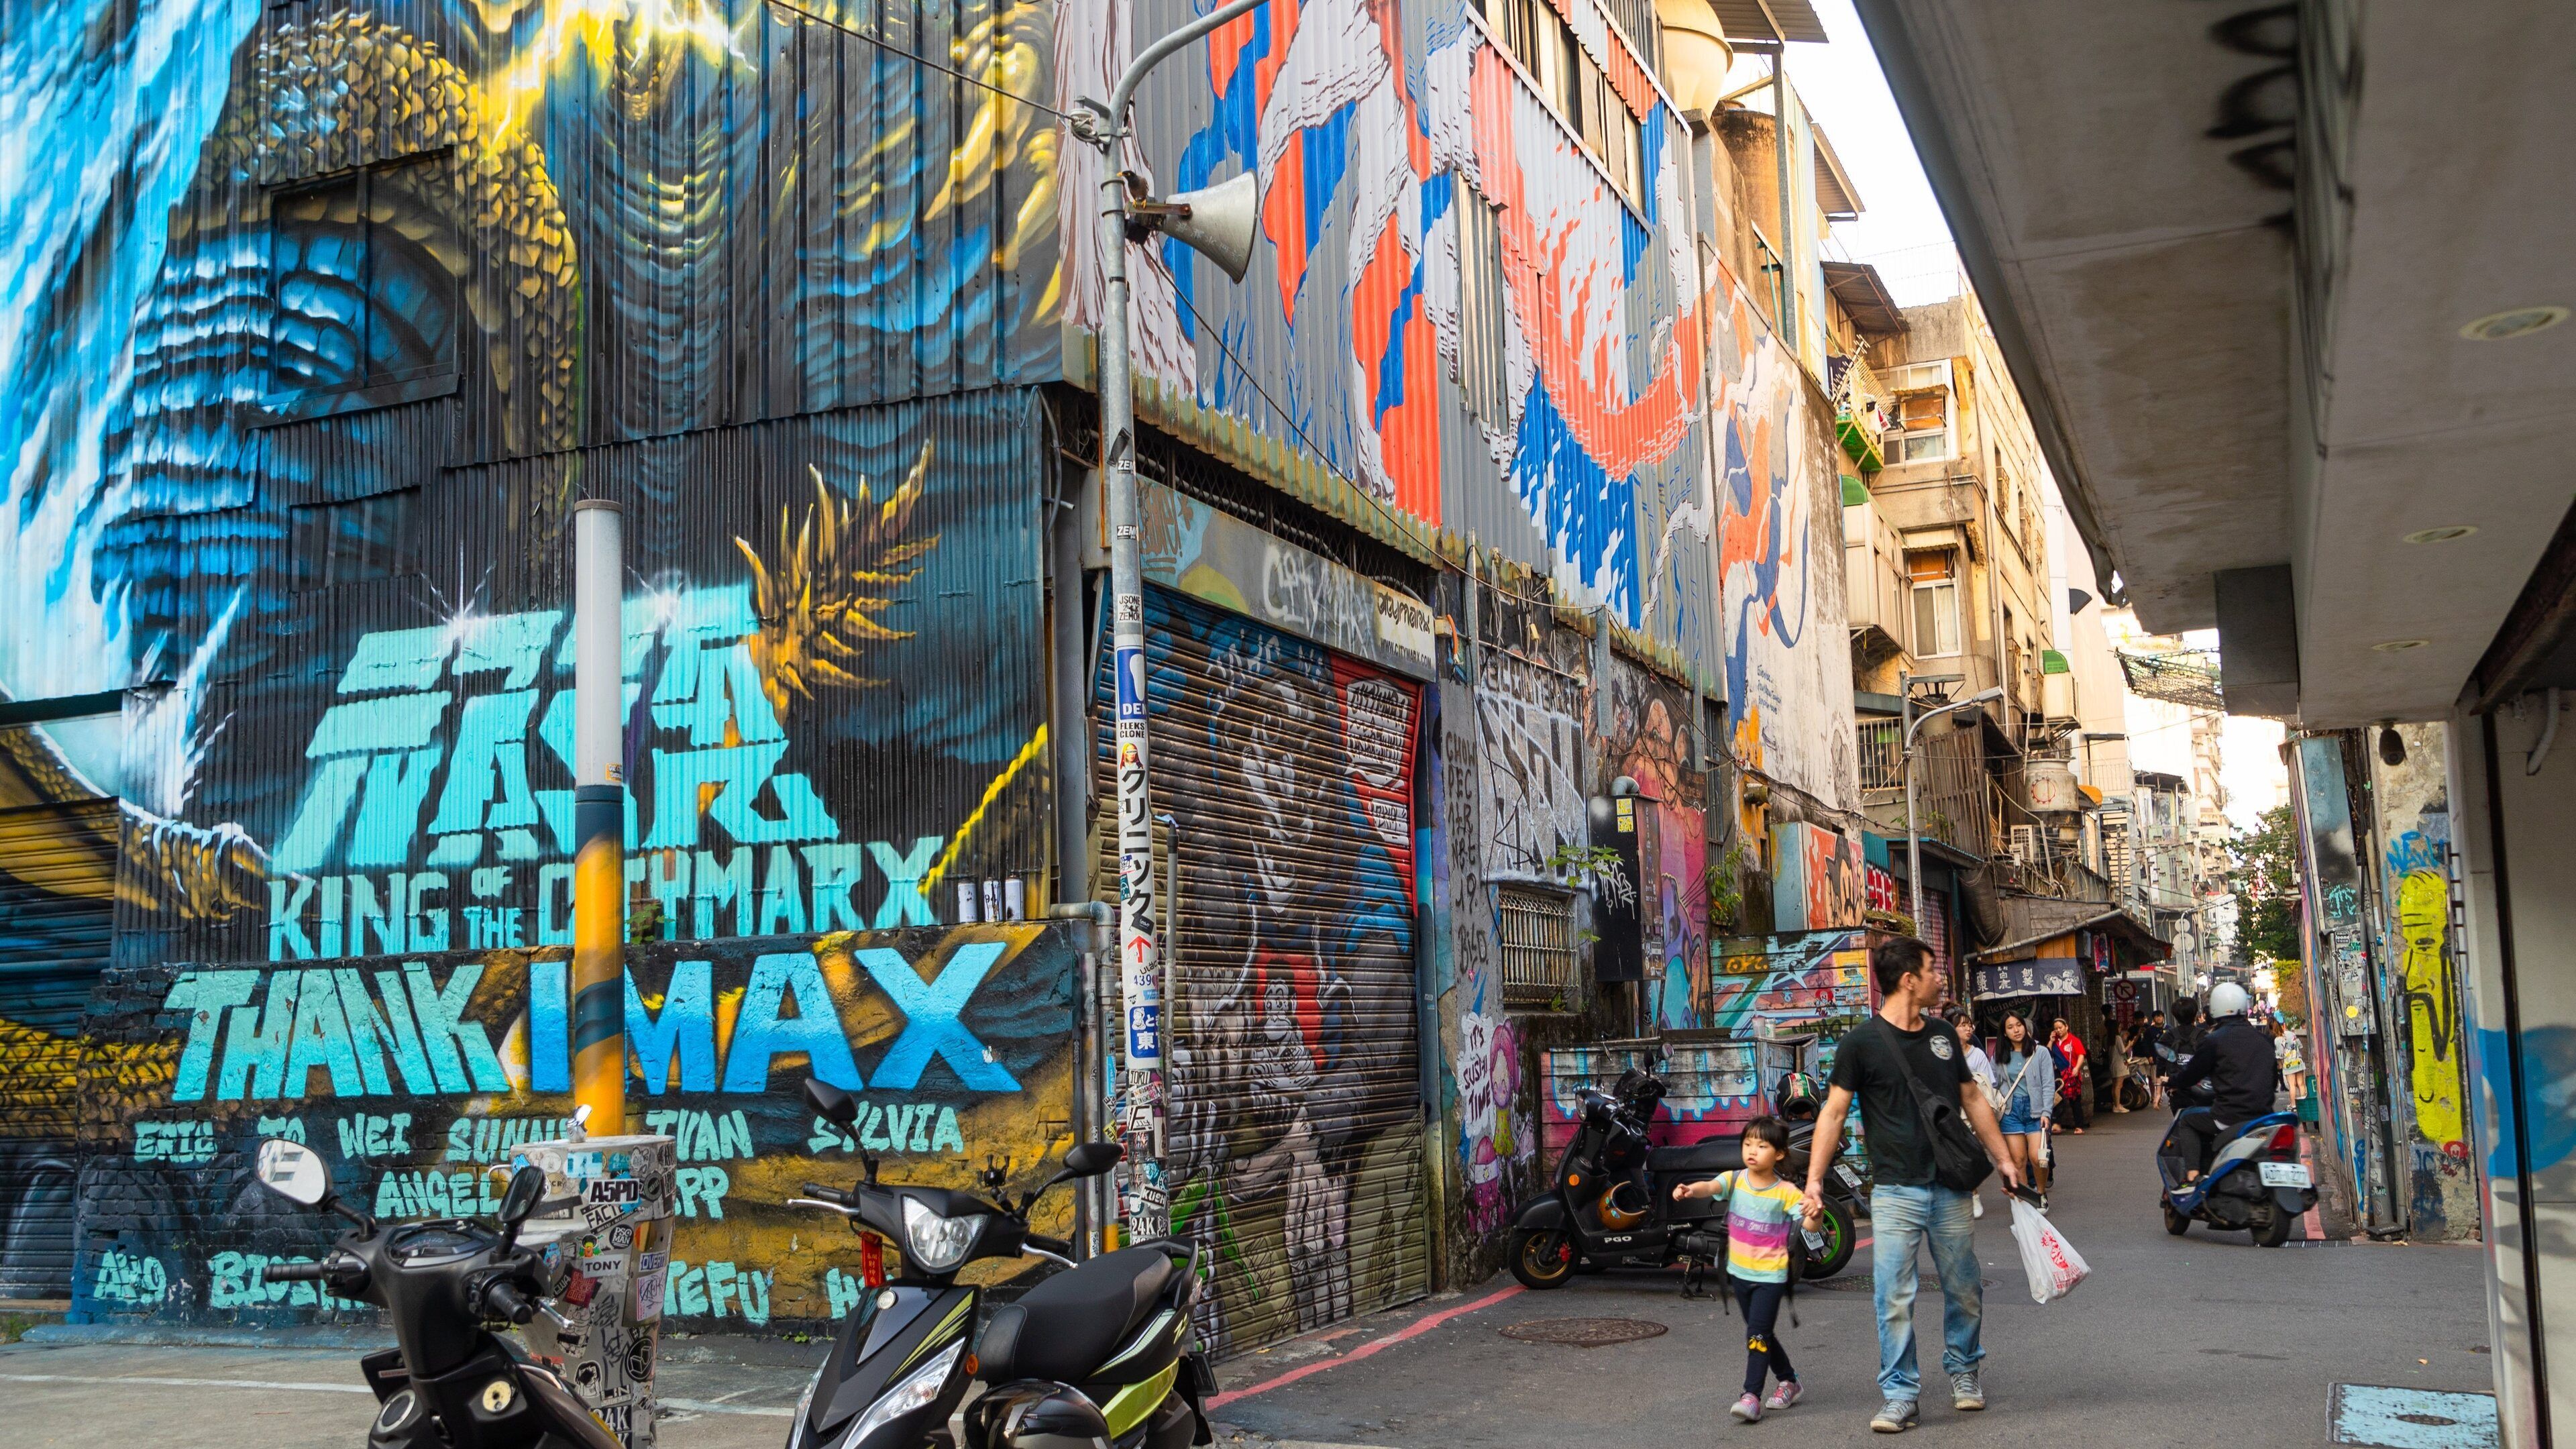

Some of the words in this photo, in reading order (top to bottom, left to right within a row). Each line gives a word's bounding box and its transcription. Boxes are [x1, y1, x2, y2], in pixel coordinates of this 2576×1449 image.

[471, 865, 513, 900] OF
[268, 870, 449, 961] KING
[463, 906, 525, 949] THE
[164, 962, 511, 1102] THANK
[1469, 1024, 1485, 1052] IT'S
[1468, 1079, 1491, 1124] TIME
[135, 1120, 218, 1163] ERIC
[337, 1112, 412, 1160] WEI
[590, 1180, 639, 1203] A5PD
[1142, 1187, 1167, 1206] KUSH
[612, 1235, 631, 1244] MAN
[1132, 1216, 1157, 1236] 24K
[1604, 1235, 1632, 1244] PGO
[586, 1260, 622, 1272] TONY
